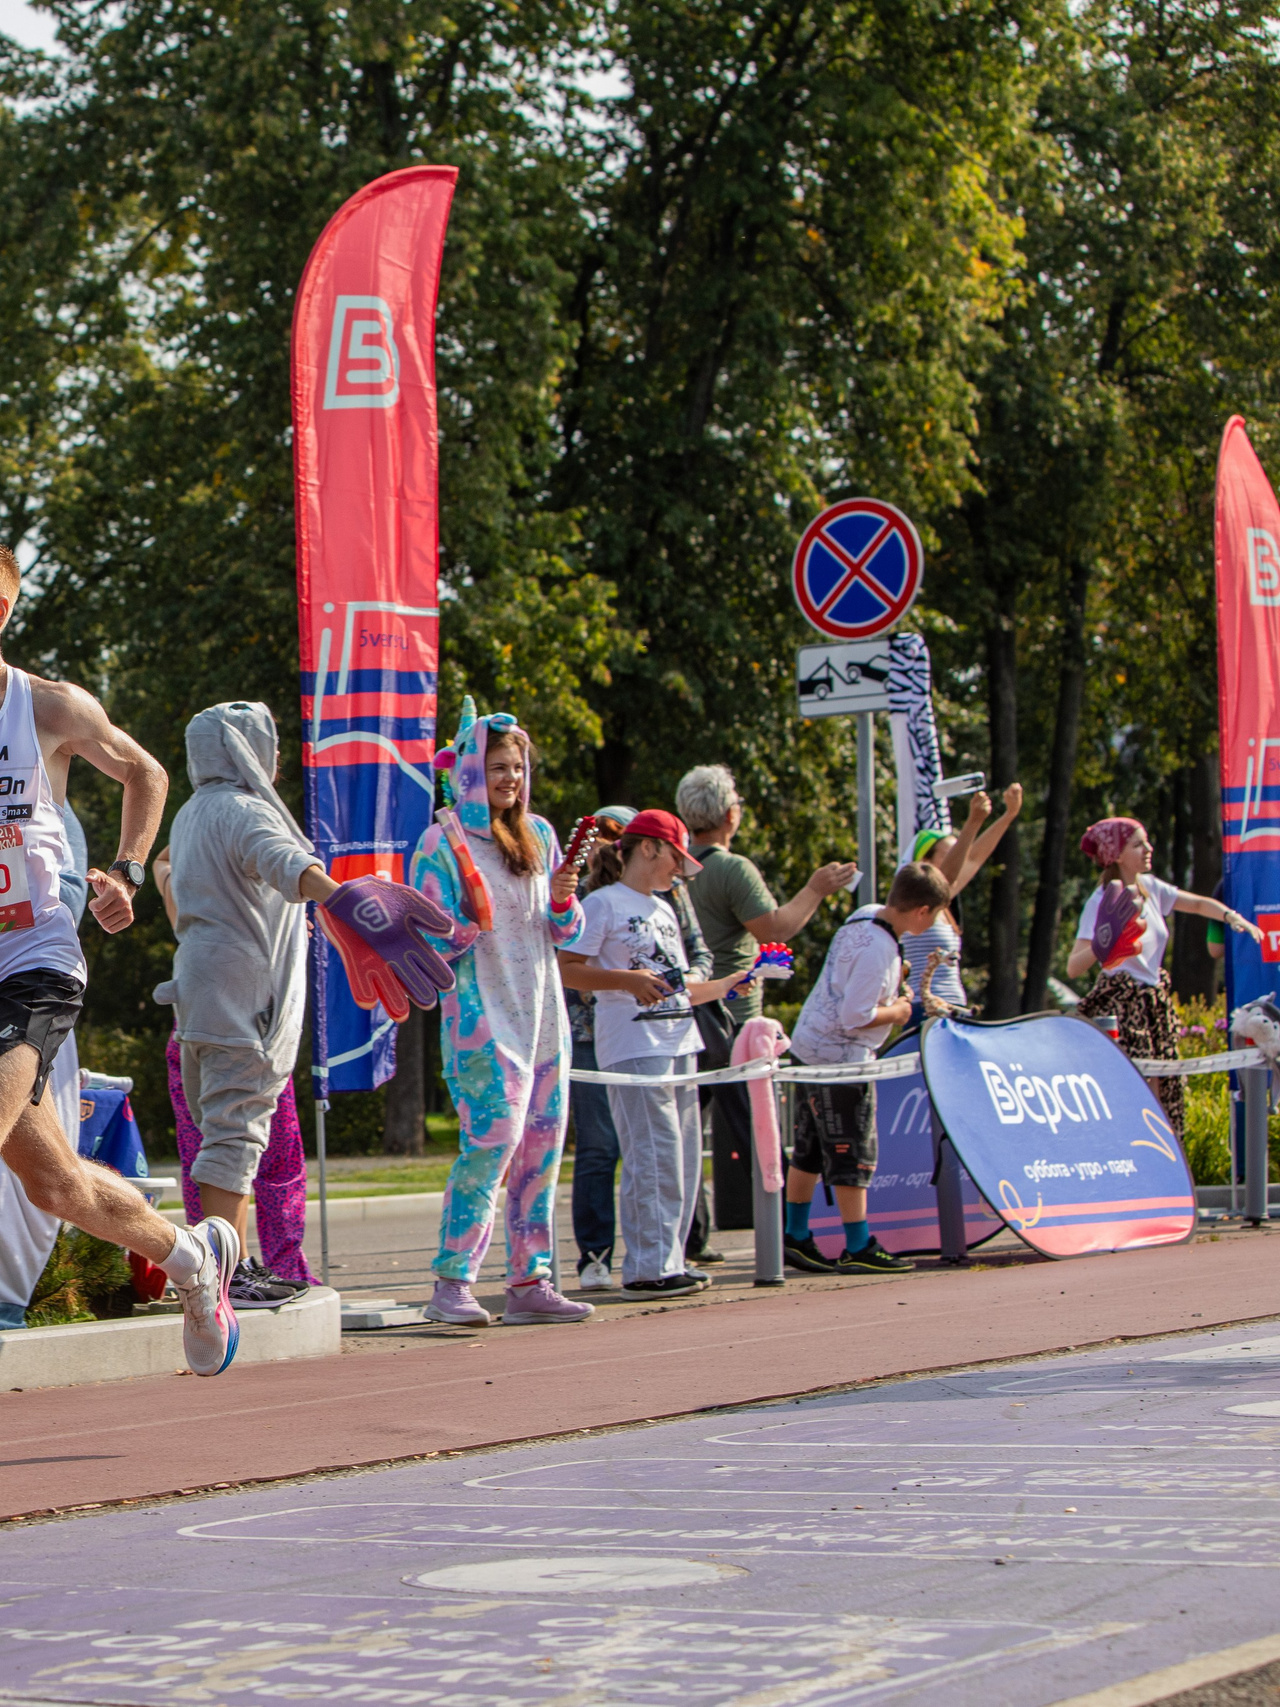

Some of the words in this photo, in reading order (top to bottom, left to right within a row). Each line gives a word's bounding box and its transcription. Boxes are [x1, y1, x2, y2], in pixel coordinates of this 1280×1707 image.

[1024, 1160, 1071, 1183] суббота
[1074, 1162, 1103, 1181] утро
[1107, 1160, 1137, 1177] парк
[899, 1477, 996, 1487] 10
[90, 1634, 225, 1650] 10
